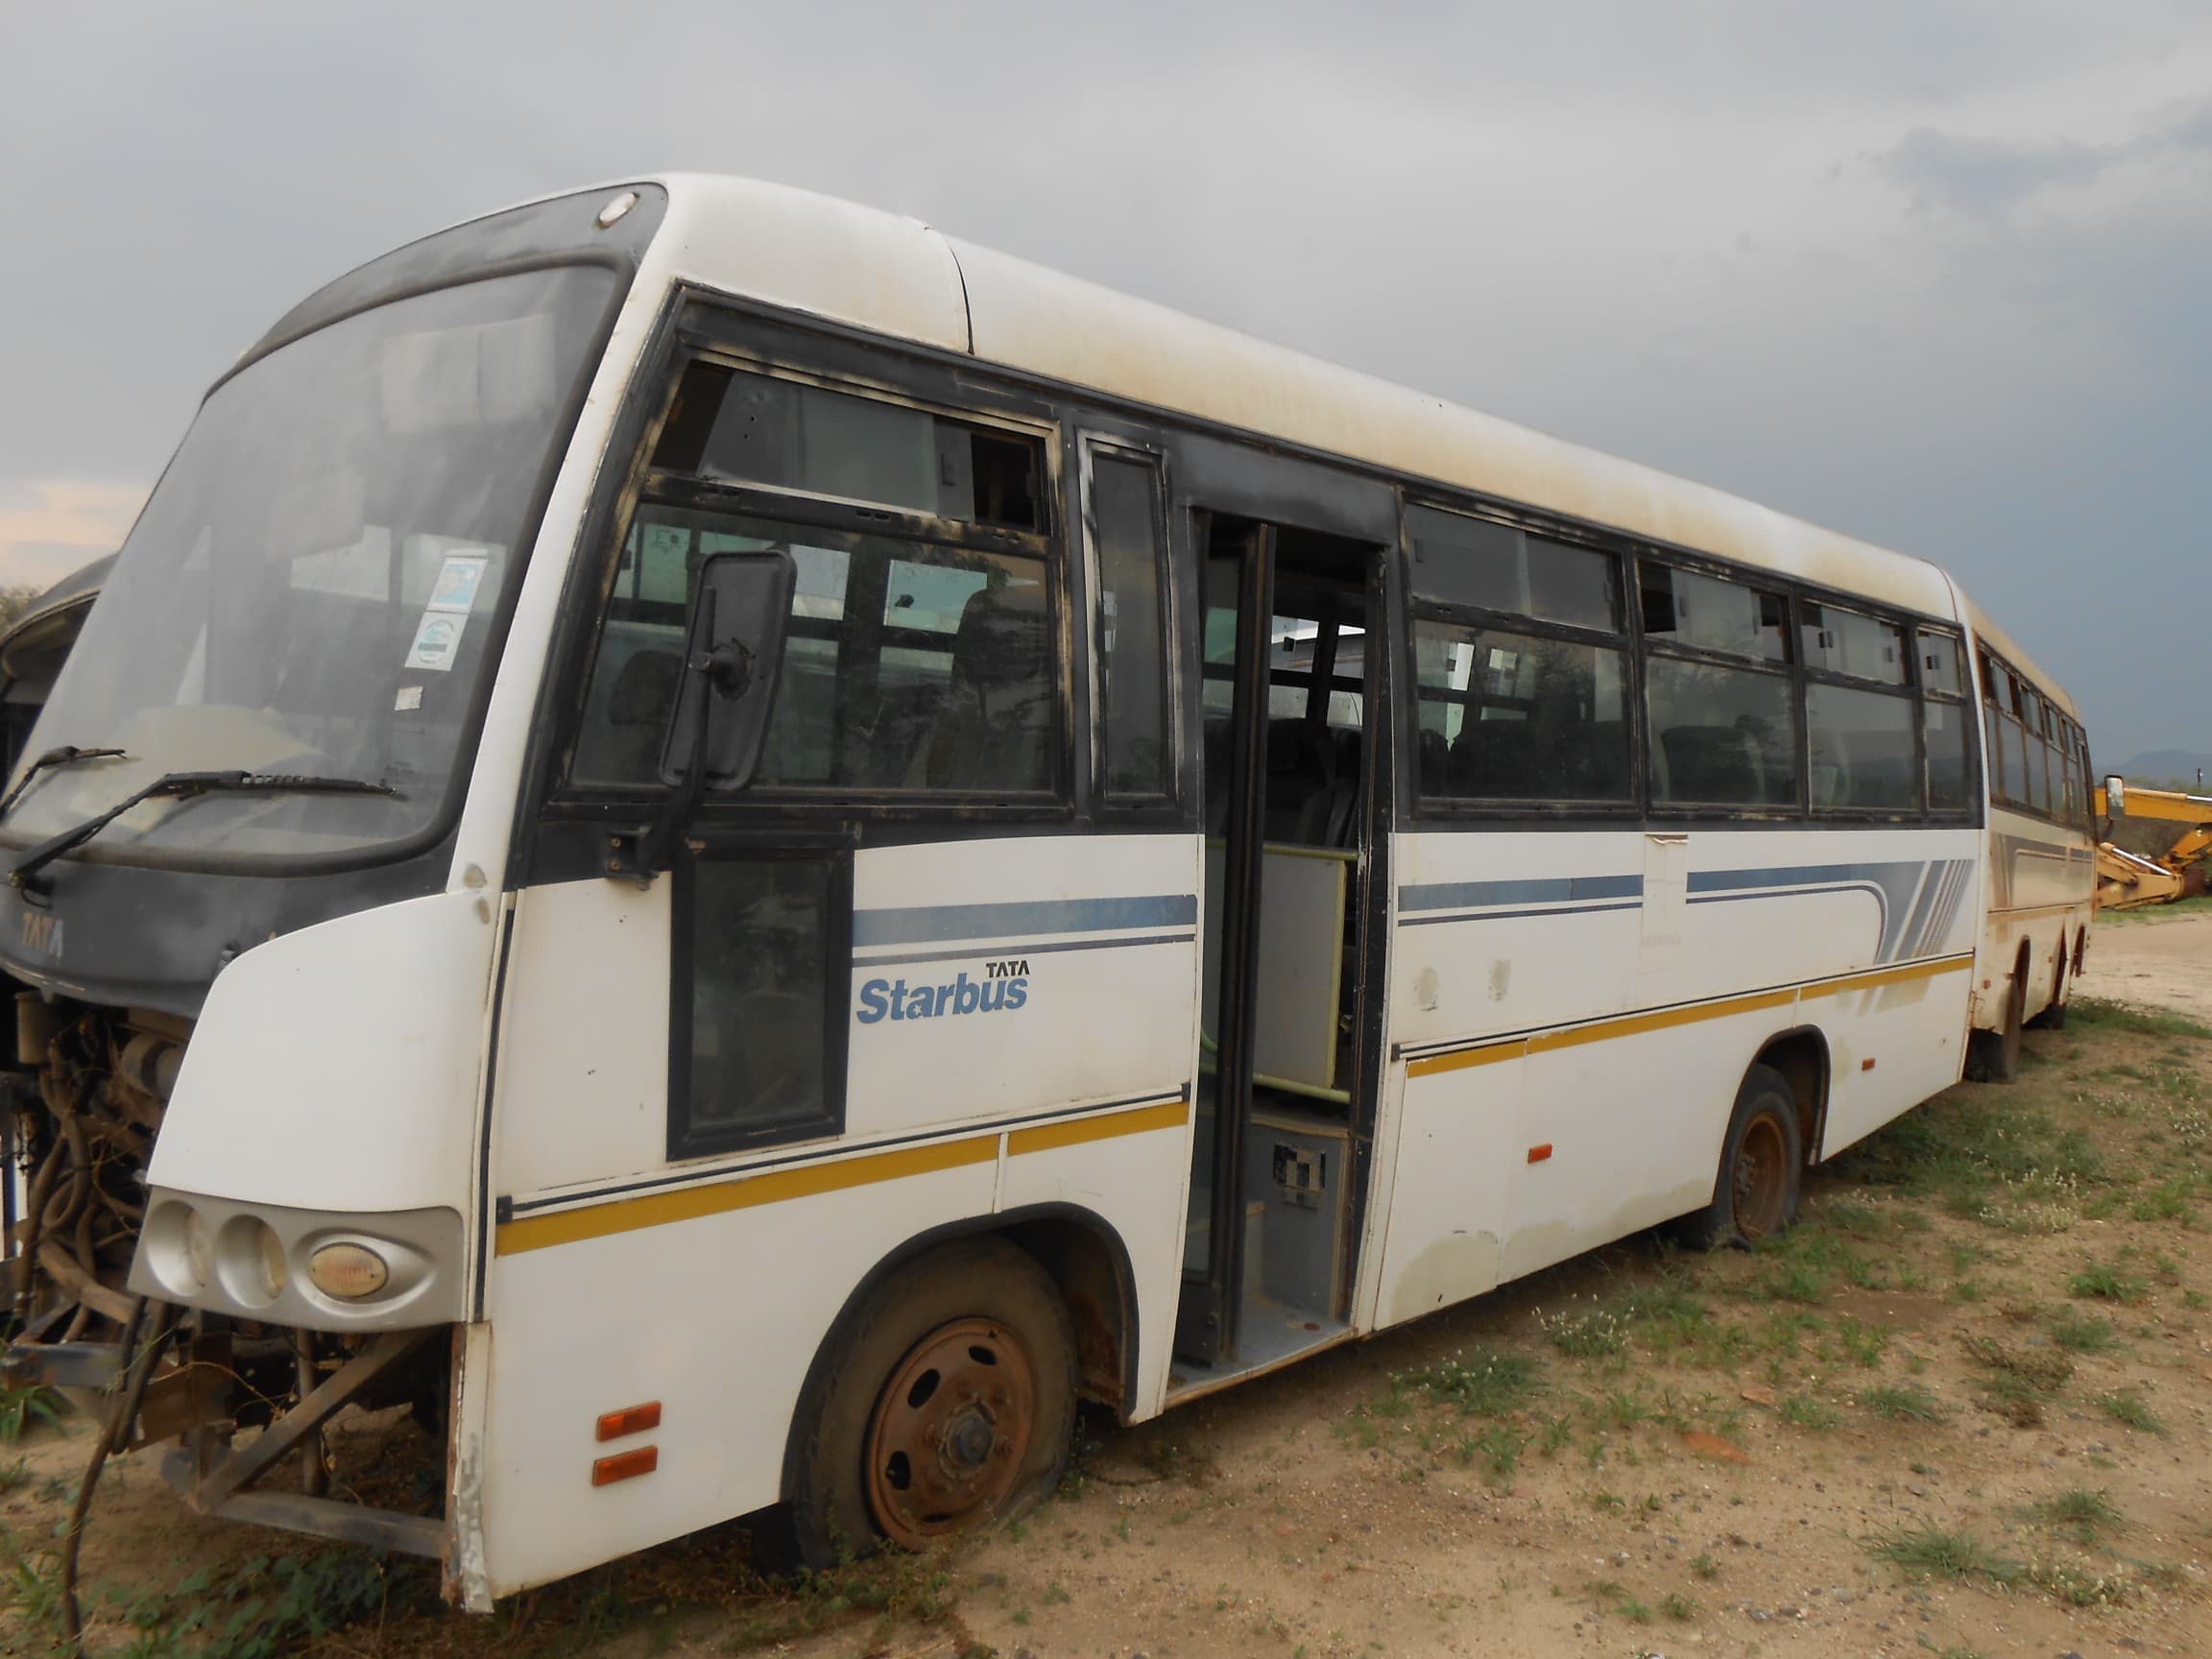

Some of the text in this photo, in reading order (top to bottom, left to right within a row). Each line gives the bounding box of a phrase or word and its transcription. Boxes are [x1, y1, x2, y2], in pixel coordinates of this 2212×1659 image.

[22, 913, 63, 957] TATA
[986, 960, 1030, 978] TATA
[857, 974, 1028, 1023] Starbus
